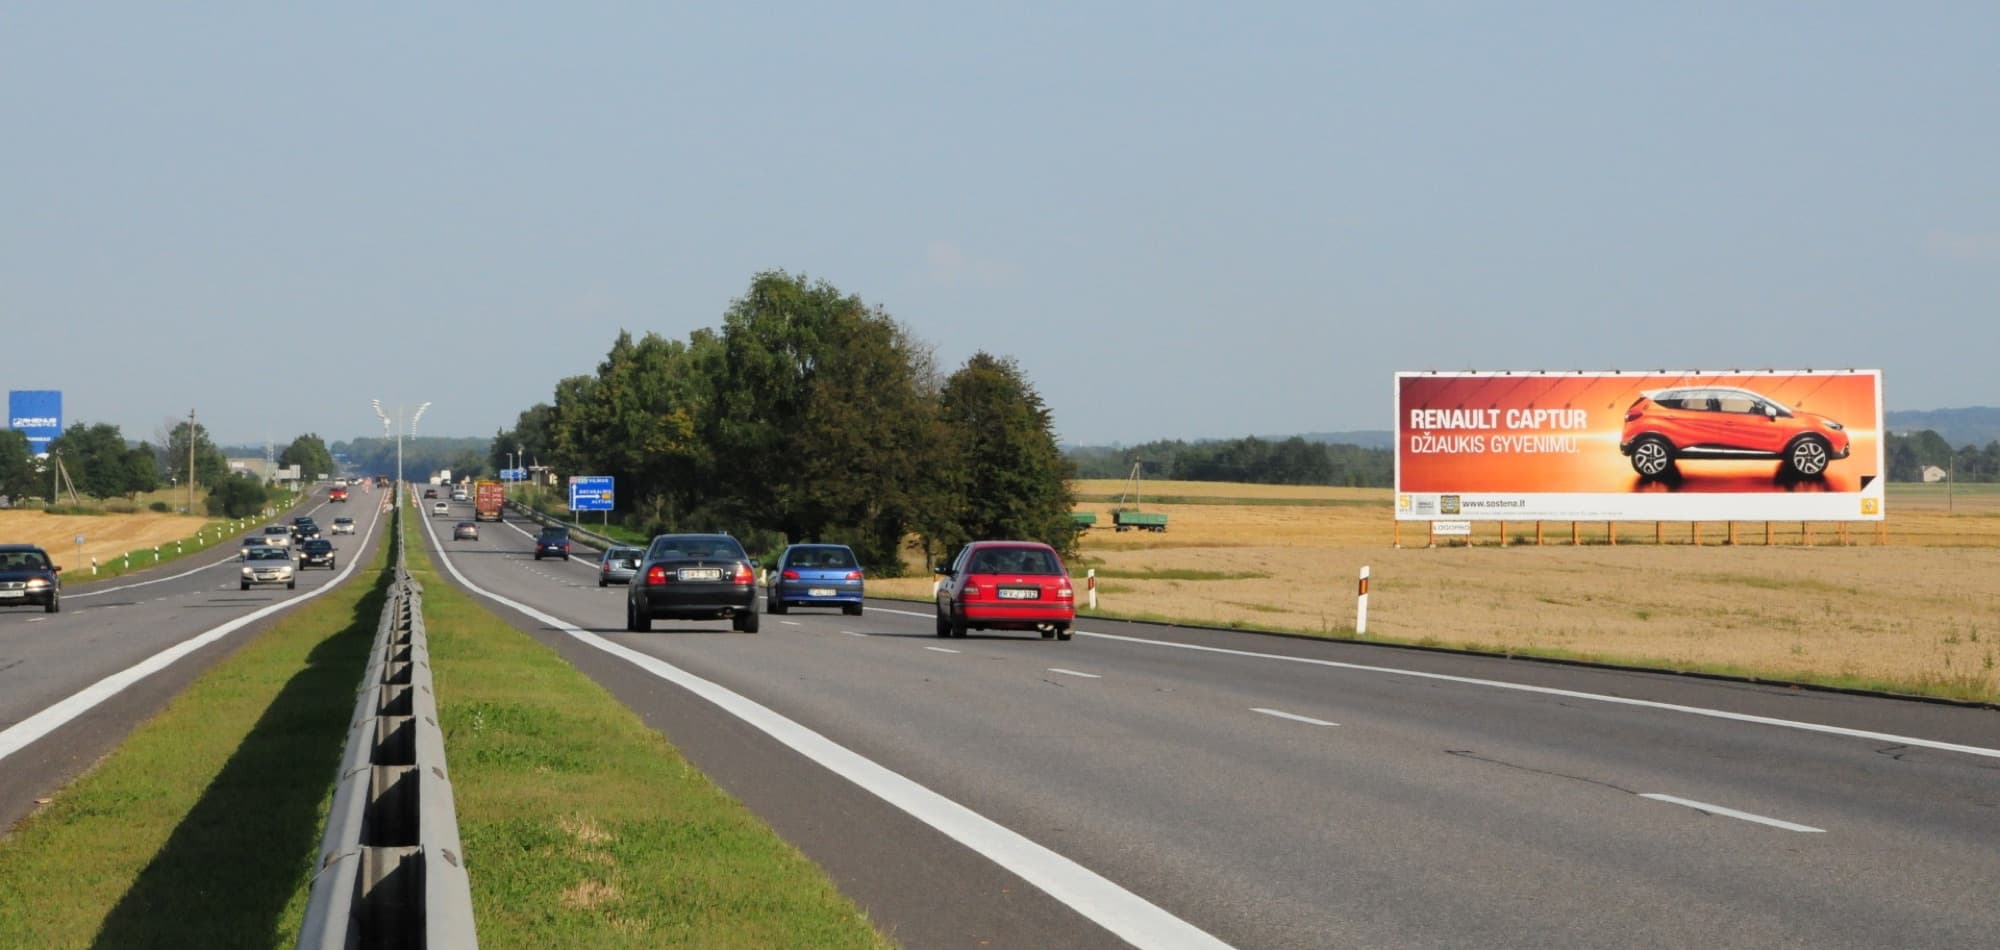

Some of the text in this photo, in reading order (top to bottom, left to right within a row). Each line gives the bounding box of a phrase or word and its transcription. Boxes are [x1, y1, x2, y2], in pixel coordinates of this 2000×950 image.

[1410, 409, 1588, 430] RENAULT CAPTUR
[1411, 431, 1485, 453] DŽIAUKIS
[1462, 499, 1526, 508] www.sostena.lt
